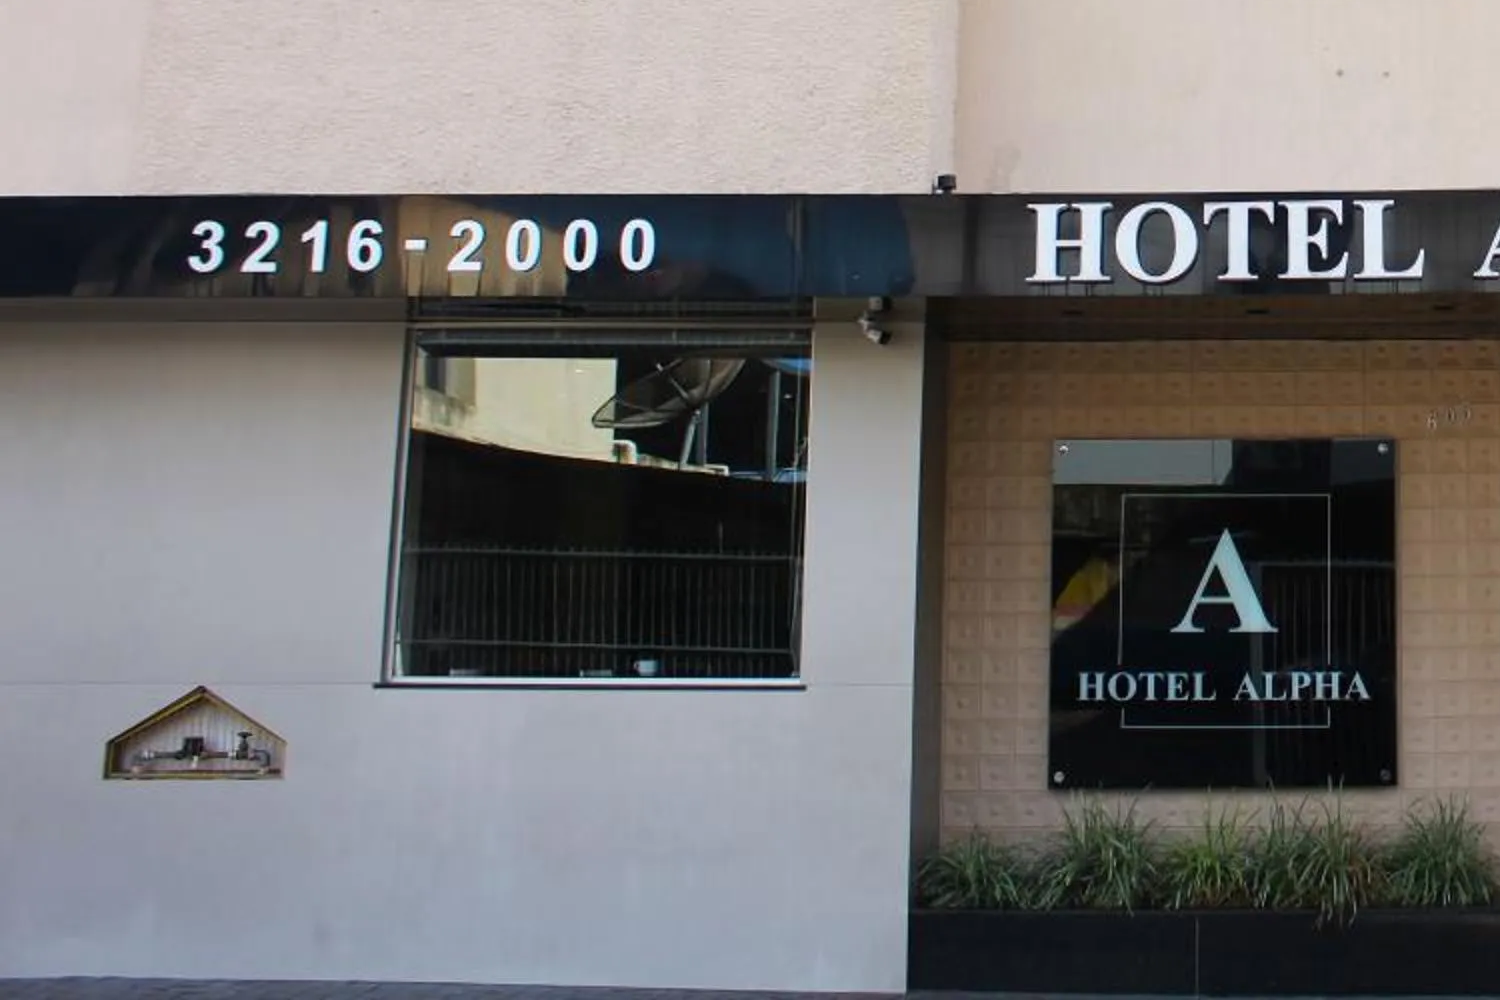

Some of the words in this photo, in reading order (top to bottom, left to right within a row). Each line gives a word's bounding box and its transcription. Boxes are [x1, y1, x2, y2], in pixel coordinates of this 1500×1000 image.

[187, 218, 656, 274] 3216-2000
[1024, 198, 1426, 284] HOTEL
[1169, 527, 1279, 634] A
[1077, 671, 1217, 702] HOTEL
[1231, 670, 1372, 701] ALPHA
